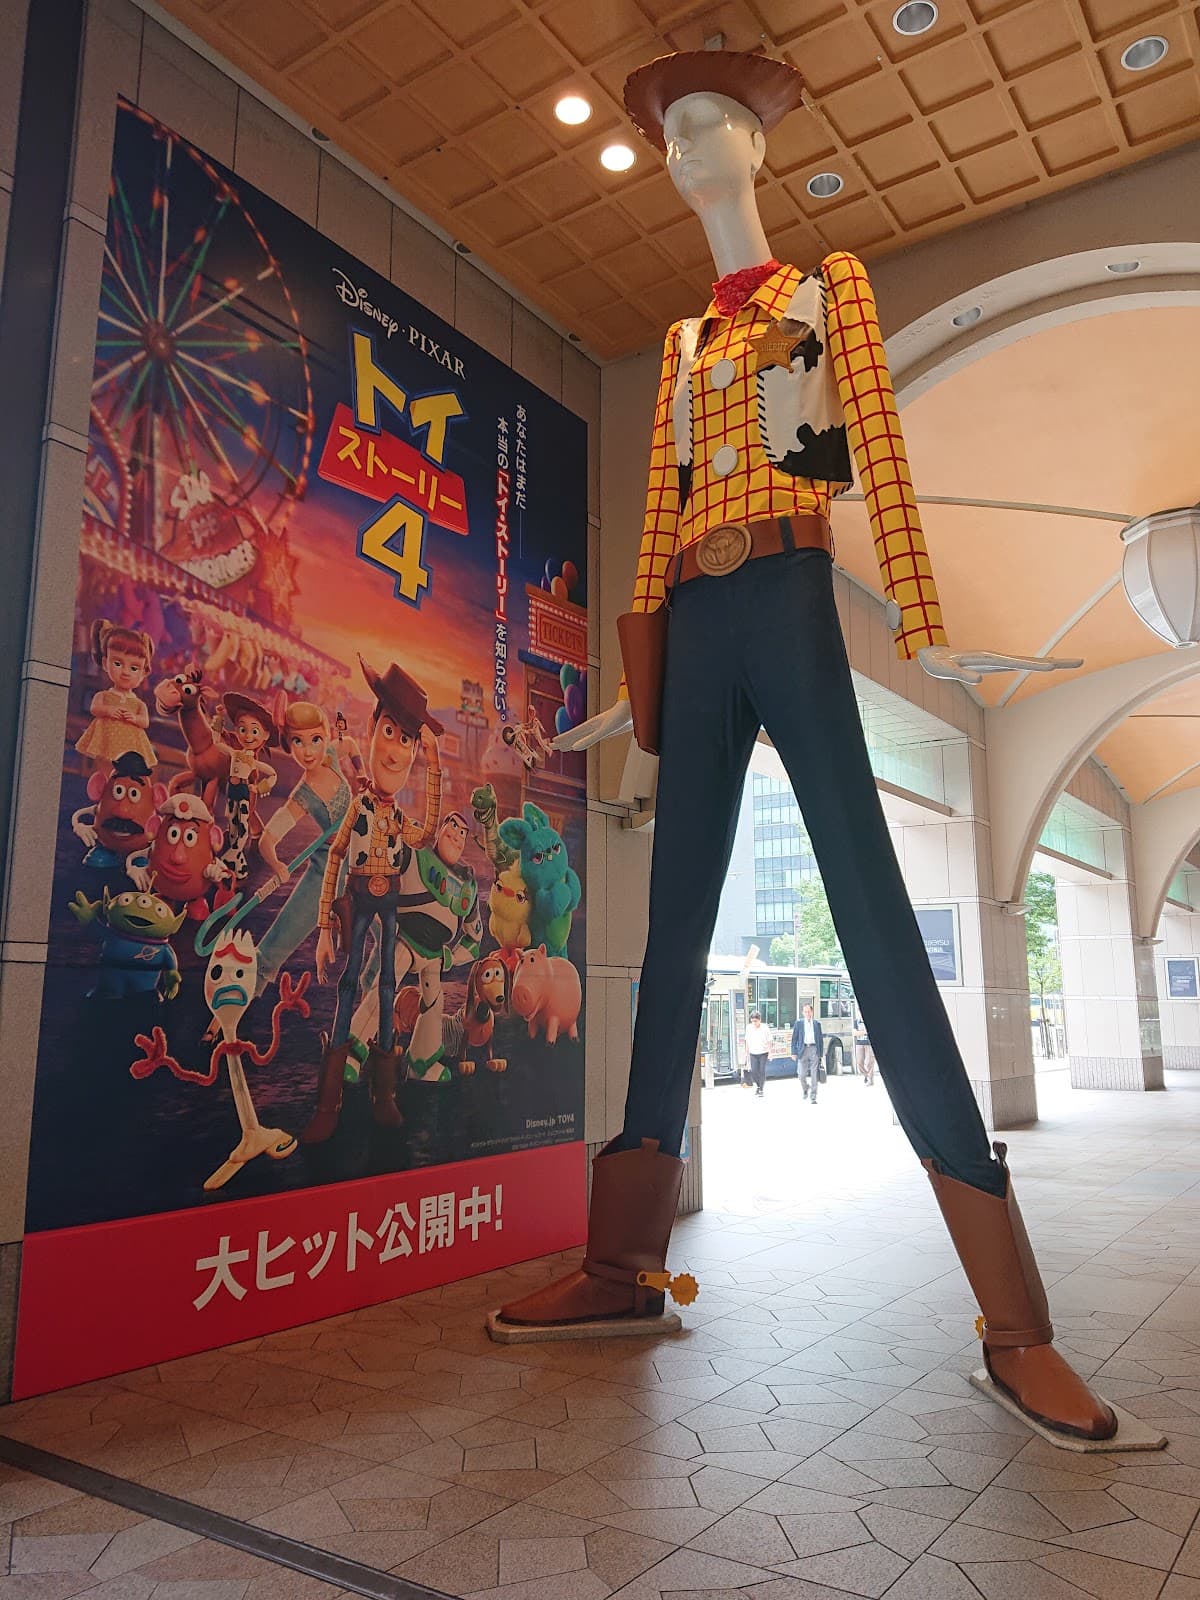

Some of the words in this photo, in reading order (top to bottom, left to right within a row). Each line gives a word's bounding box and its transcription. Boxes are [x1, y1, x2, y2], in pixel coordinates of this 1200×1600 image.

[332, 267, 399, 340] Disney
[407, 326, 466, 380] PIXAR
[353, 332, 464, 464] トイ
[336, 425, 463, 511] ストーリー
[361, 500, 429, 601] 4
